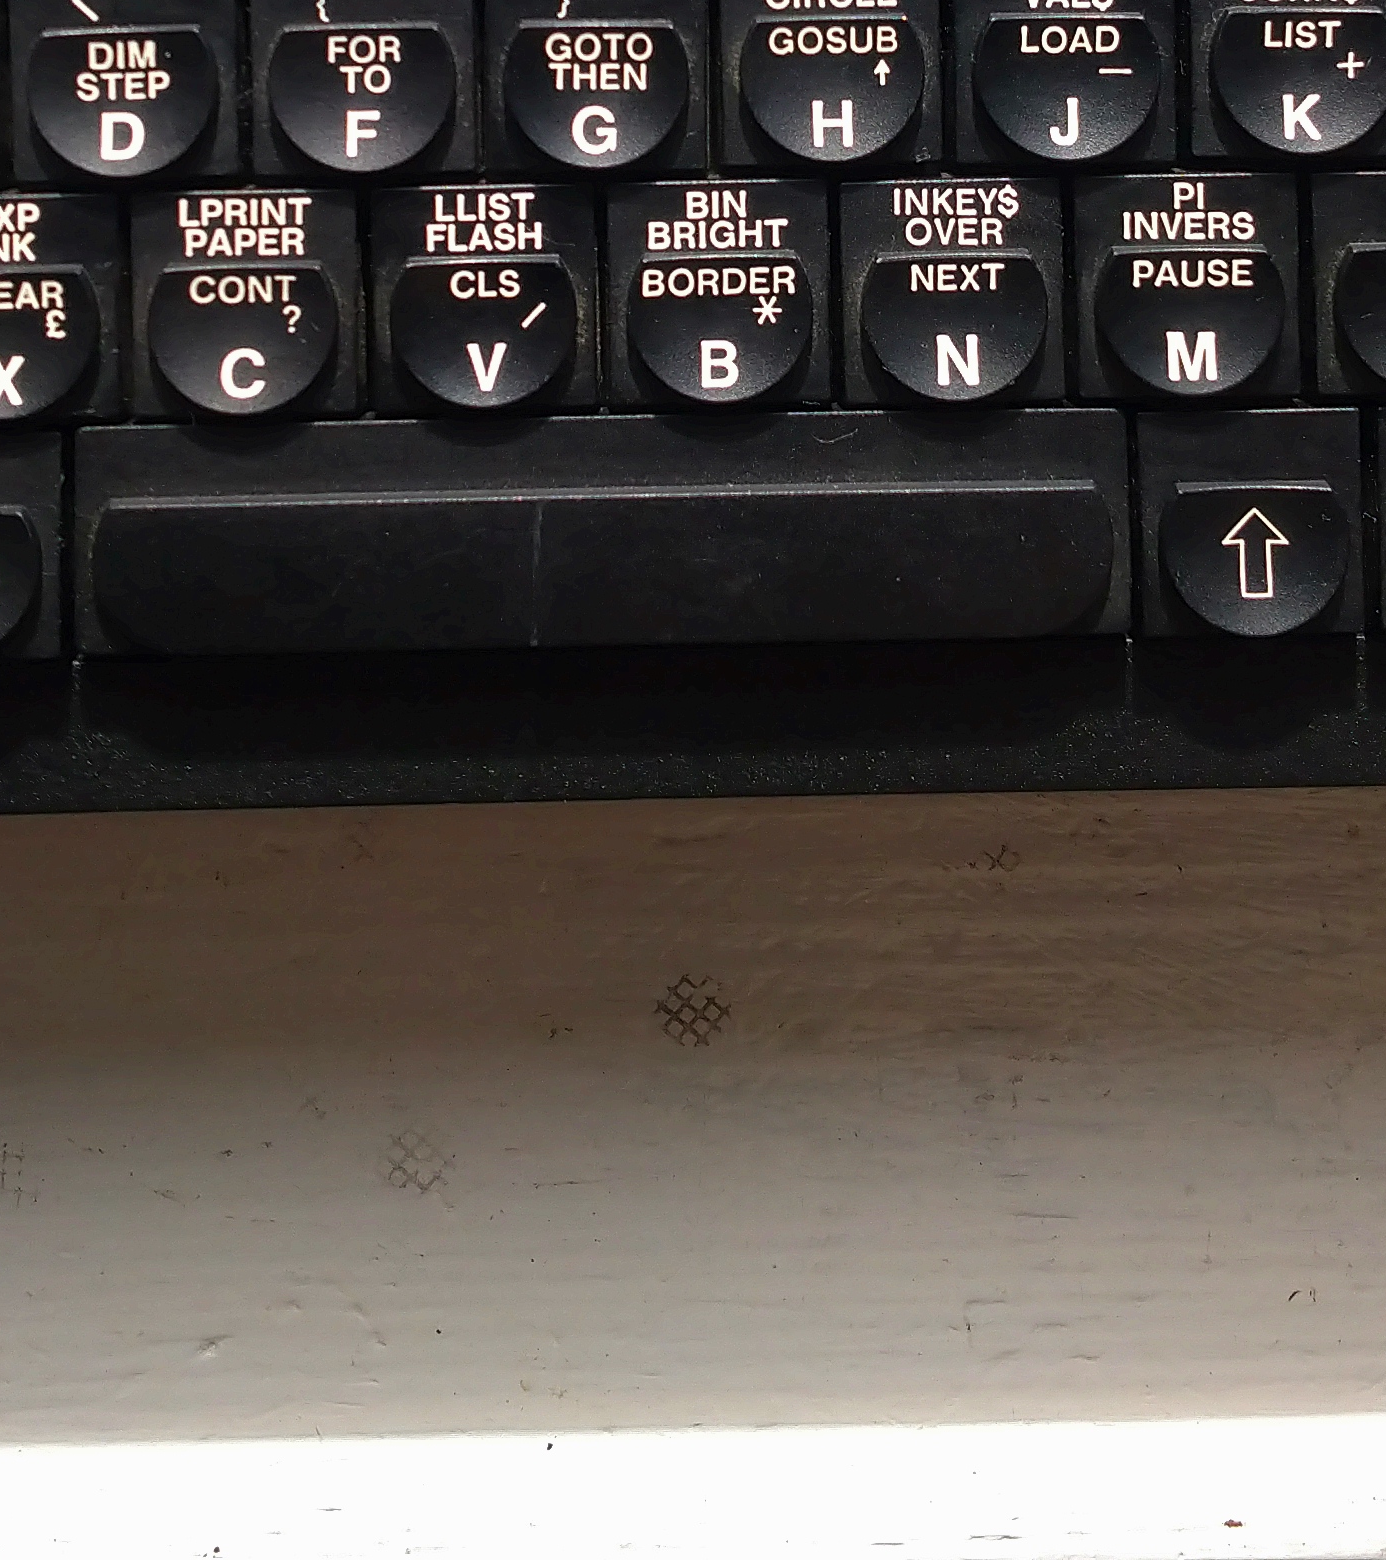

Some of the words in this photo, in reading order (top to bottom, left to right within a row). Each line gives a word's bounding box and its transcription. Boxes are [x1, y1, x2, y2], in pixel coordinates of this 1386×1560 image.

[327, 35, 401, 64] FOR
[545, 32, 653, 62] GOTO
[768, 25, 898, 56] GOSUB
[1020, 25, 1120, 54] LOAD
[1264, 20, 1342, 49] LIST
[88, 40, 157, 71] DIM
[76, 70, 171, 102] STEP
[339, 64, 392, 94] TO
[548, 62, 647, 91] THEN
[571, 105, 618, 156] G
[811, 99, 854, 148] H
[1282, 93, 1323, 142] K
[100, 111, 145, 161] D
[345, 110, 381, 158] F
[434, 191, 535, 222] LLIST
[685, 189, 747, 220] BIN
[893, 183, 1020, 219] INKEY$
[1173, 181, 1205, 210] PI
[178, 197, 313, 228] LPRINT
[1122, 211, 1256, 241] INVERS
[184, 227, 305, 258] PAPER
[426, 221, 543, 253] FLASH
[647, 218, 789, 250] BRIGHT
[905, 217, 1003, 247] OVER
[450, 269, 521, 300] CLS
[642, 265, 796, 298] BORDER
[910, 262, 1005, 292] NEXT
[1132, 258, 1254, 288] PAUSE
[189, 275, 297, 304] CONT
[700, 339, 740, 389] B
[935, 333, 981, 387] N
[1165, 331, 1218, 382] M
[220, 347, 266, 400] C
